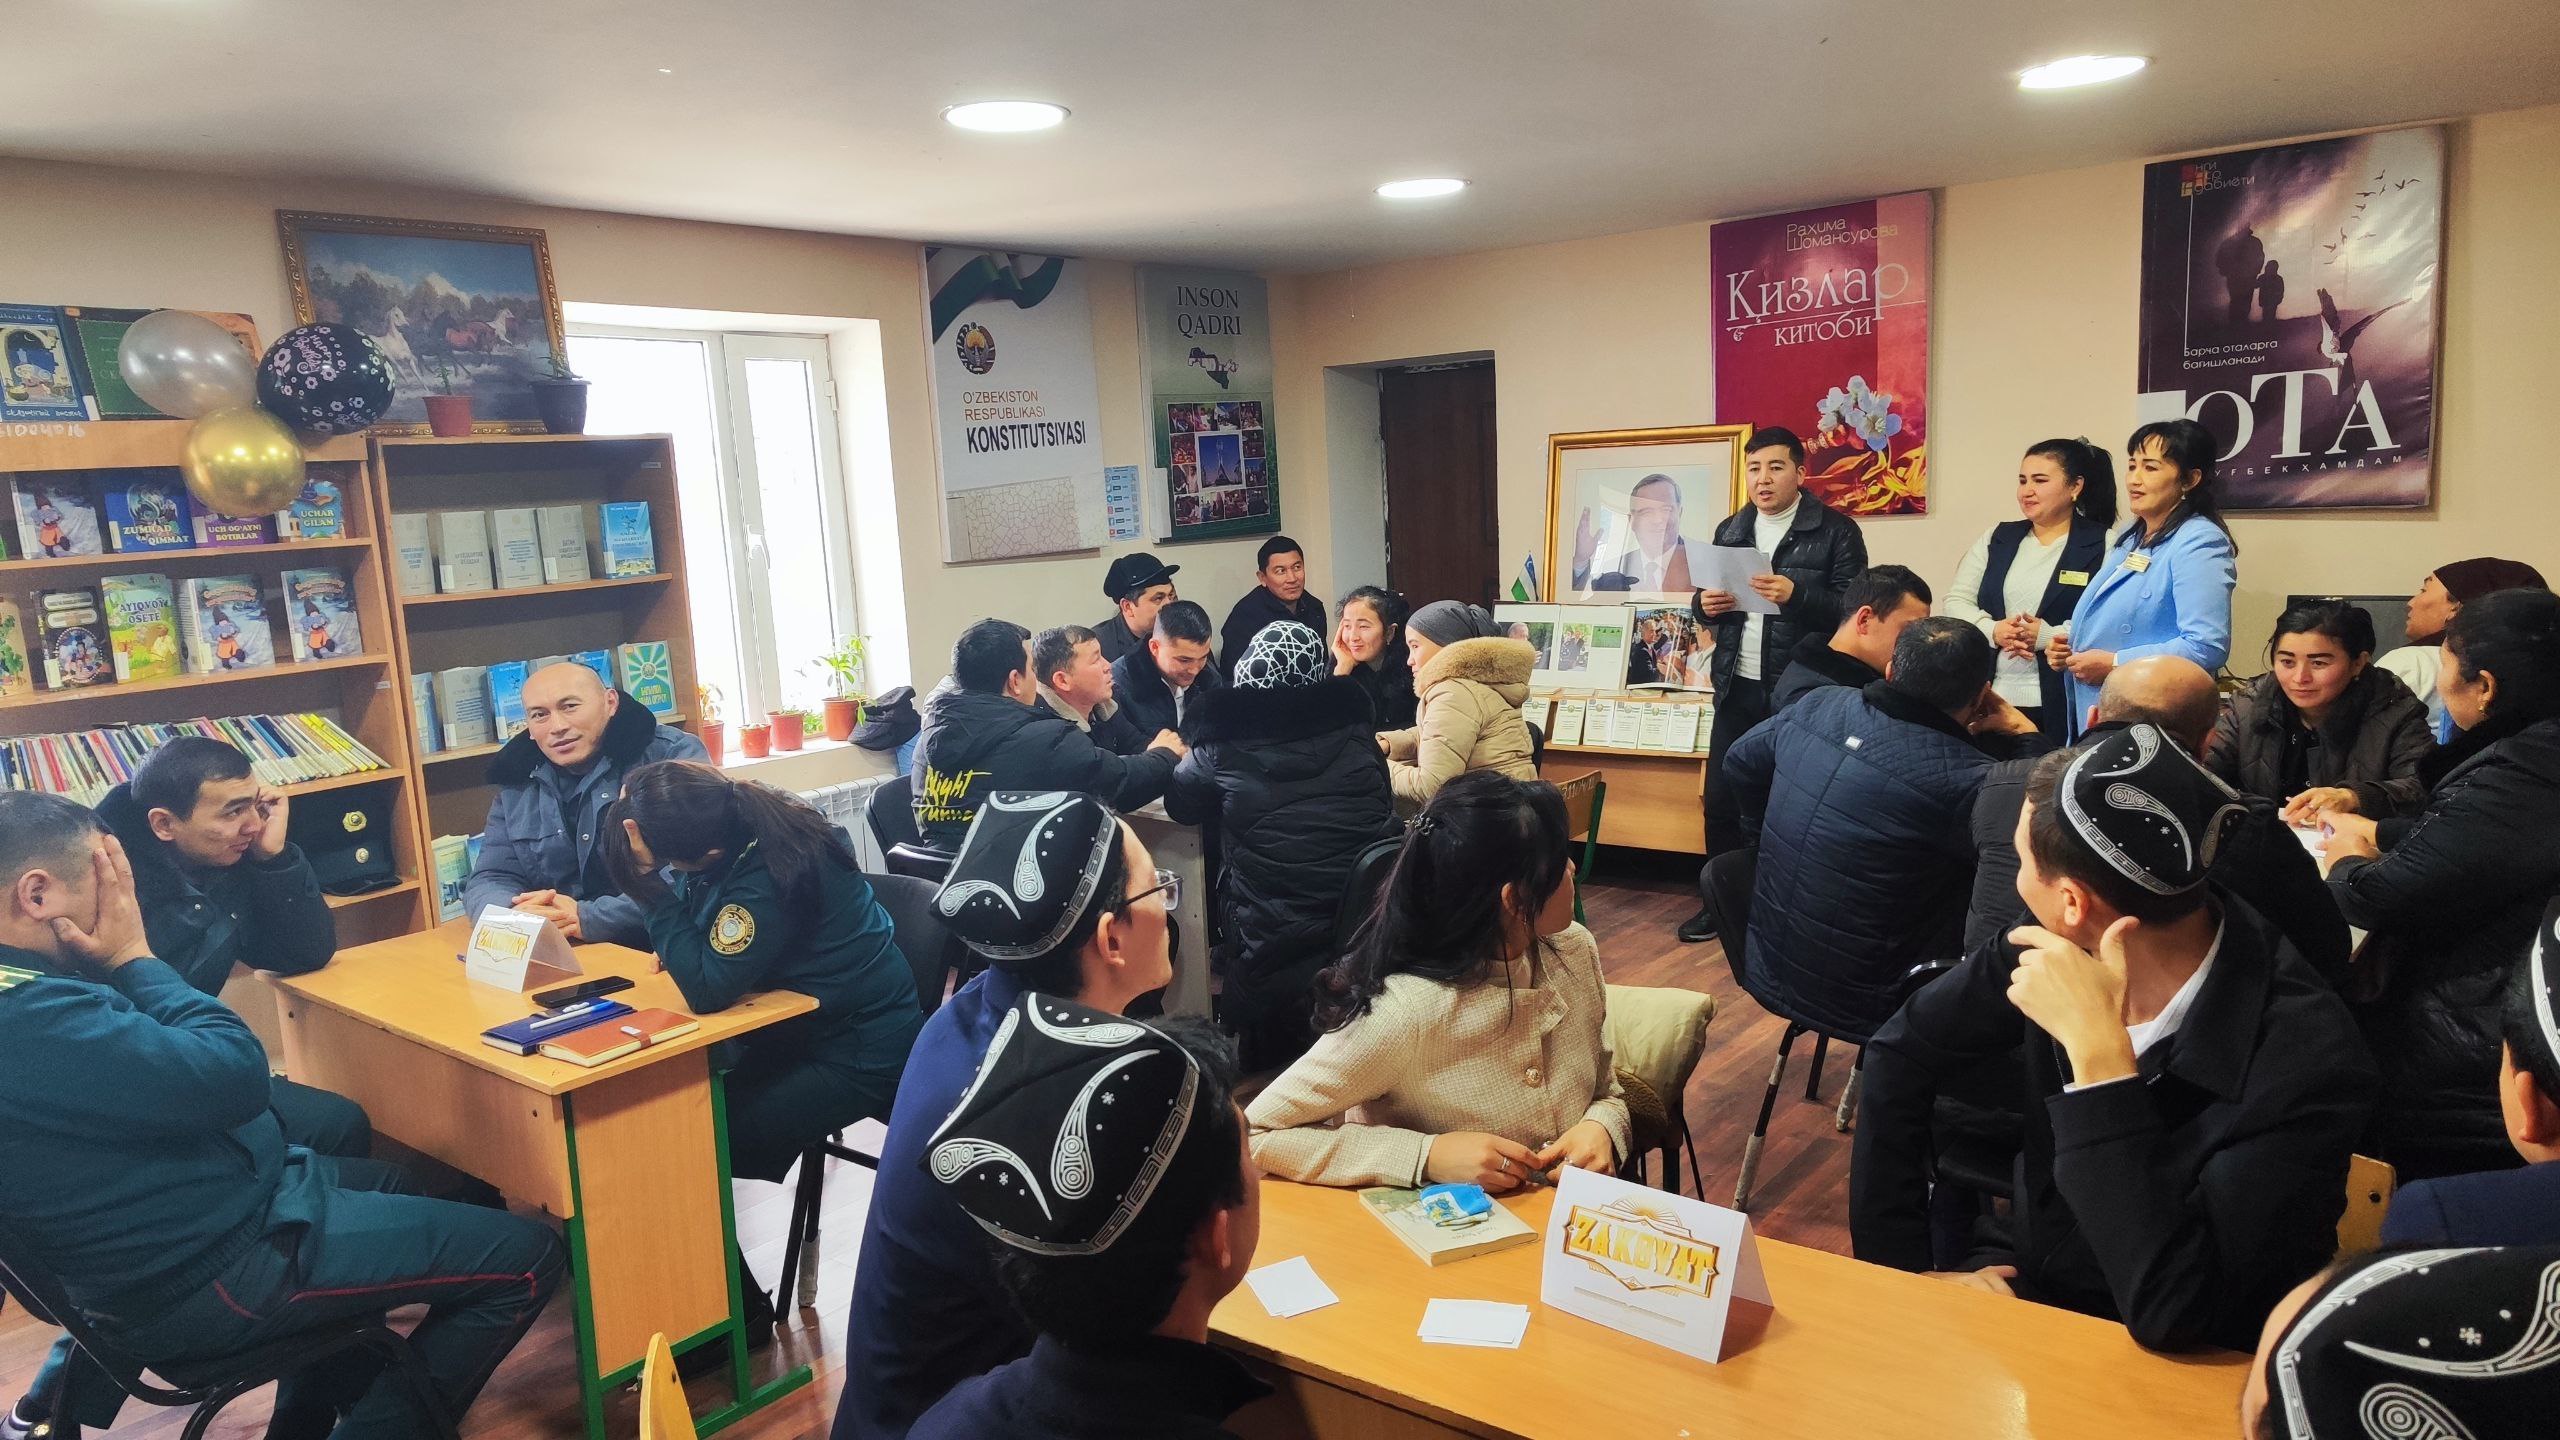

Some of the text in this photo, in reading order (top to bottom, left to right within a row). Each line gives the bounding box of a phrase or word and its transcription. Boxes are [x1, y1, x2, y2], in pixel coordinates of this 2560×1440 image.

[1177, 286, 1238, 309] INSON
[1178, 313, 1242, 338] QADRI
[1774, 307, 1873, 346] китоби
[2184, 340, 2278, 358] Барча оталарга
[963, 390, 1039, 404] O'ZBEKISTON
[965, 407, 1046, 421] RESPUBLIKASI
[966, 420, 1086, 453] KONSTITUTSIYASI
[301, 509, 334, 518] UCHAR
[208, 525, 227, 533] UCH
[303, 518, 335, 527] GILAM
[148, 535, 189, 546] QIMMAT
[215, 532, 258, 541] BOTIRLAR
[1569, 1214, 1715, 1287] ZAKOVAT
